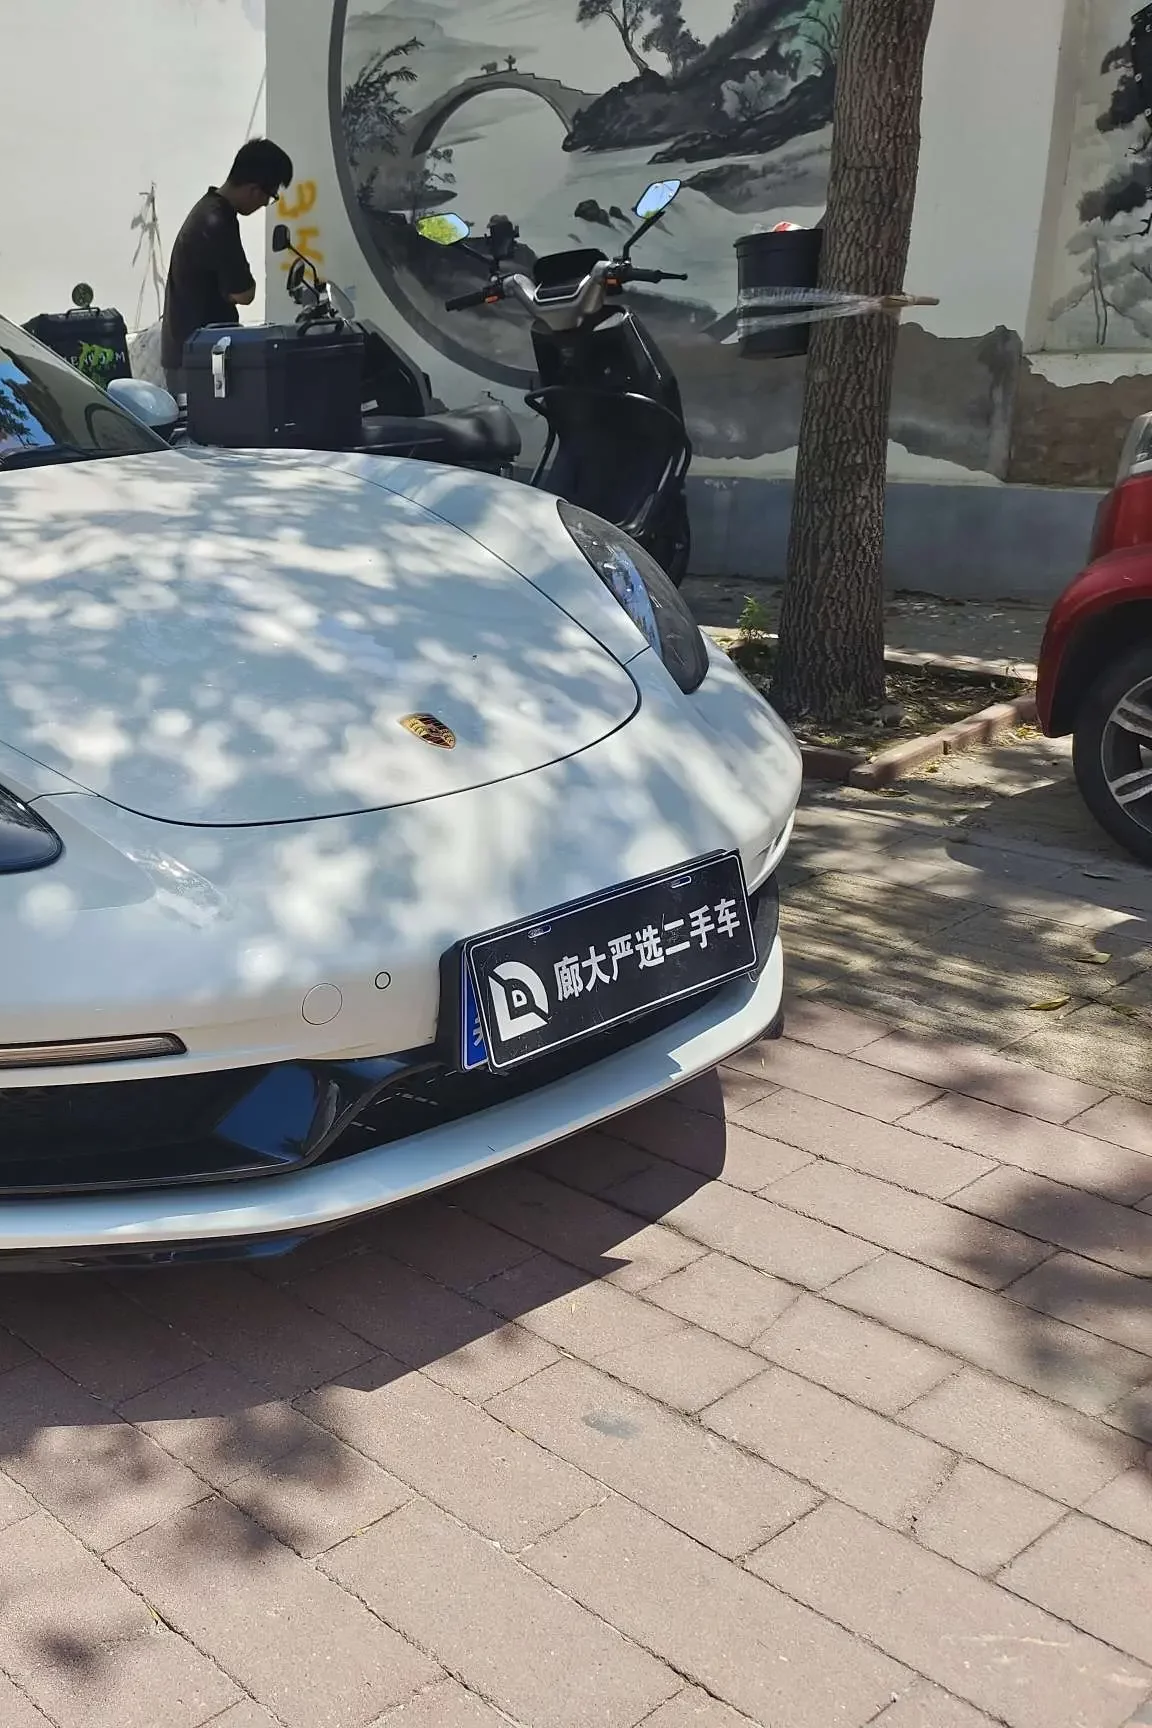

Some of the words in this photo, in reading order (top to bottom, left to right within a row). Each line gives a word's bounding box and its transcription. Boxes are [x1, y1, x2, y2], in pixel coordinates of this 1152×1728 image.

[553, 898, 741, 1001] 廊大严选二手车
